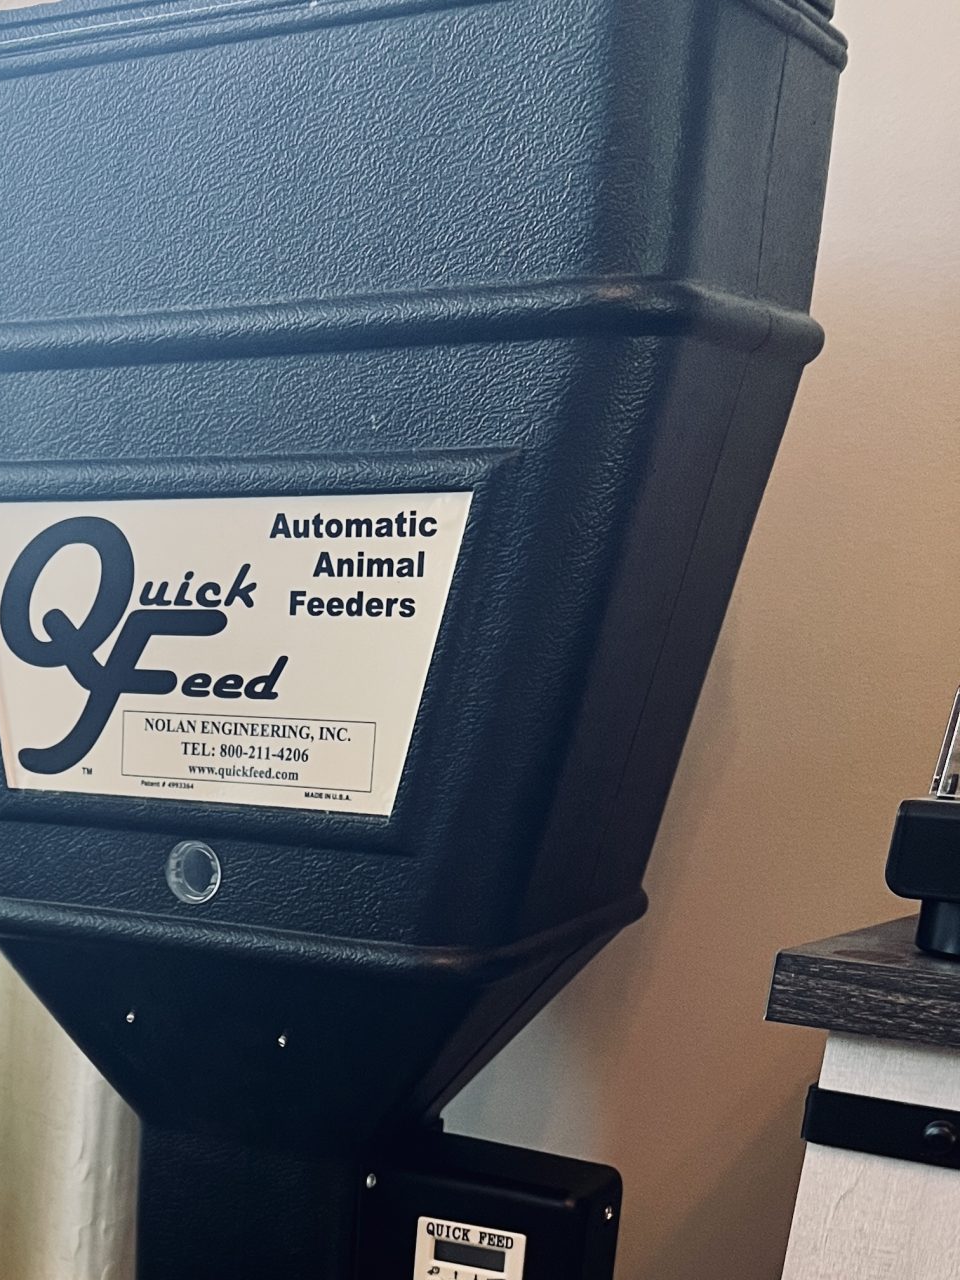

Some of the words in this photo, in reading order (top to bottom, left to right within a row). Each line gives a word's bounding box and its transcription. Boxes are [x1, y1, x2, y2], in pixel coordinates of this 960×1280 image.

[269, 511, 439, 540] Automatic
[312, 551, 426, 579] Animal
[0, 516, 257, 680] Quick
[289, 590, 416, 618] Feeders
[18, 608, 289, 775] Feed
[144, 718, 197, 733] NOLAN
[200, 721, 315, 742] ENGINEERING,
[319, 726, 352, 742] INC.
[181, 741, 216, 757] TEL:
[219, 743, 310, 763] 800-211-4206
[188, 764, 300, 782] www.quickfeed.com
[426, 1222, 470, 1242] QUICK
[478, 1231, 514, 1250] FEED
